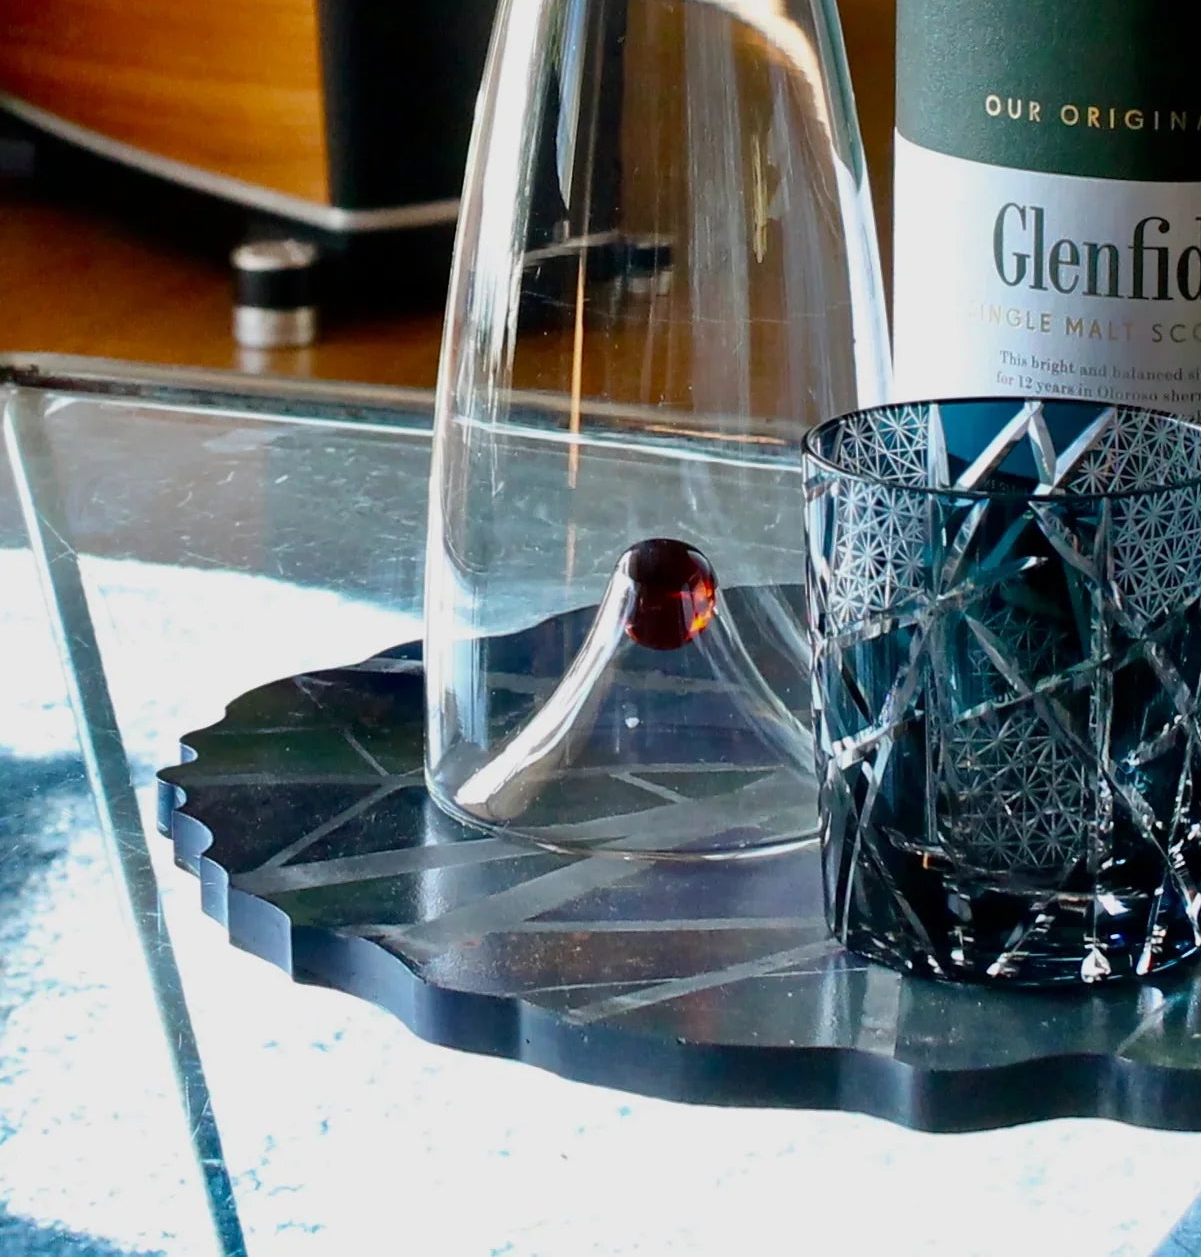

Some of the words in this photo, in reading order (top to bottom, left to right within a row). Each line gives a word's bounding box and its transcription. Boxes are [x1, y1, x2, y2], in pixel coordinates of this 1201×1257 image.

[985, 94, 1041, 123] OUR
[1065, 316, 1134, 342] MALT
[1000, 350, 1028, 367] This
[1031, 355, 1075, 375] bright
[1080, 365, 1107, 377] and
[1113, 366, 1183, 381] balanced
[996, 371, 1014, 385] for
[1018, 375, 1033, 390] 12
[1036, 381, 1074, 394] years
[1078, 383, 1093, 396] in
[1097, 385, 1158, 402] Oloroso
